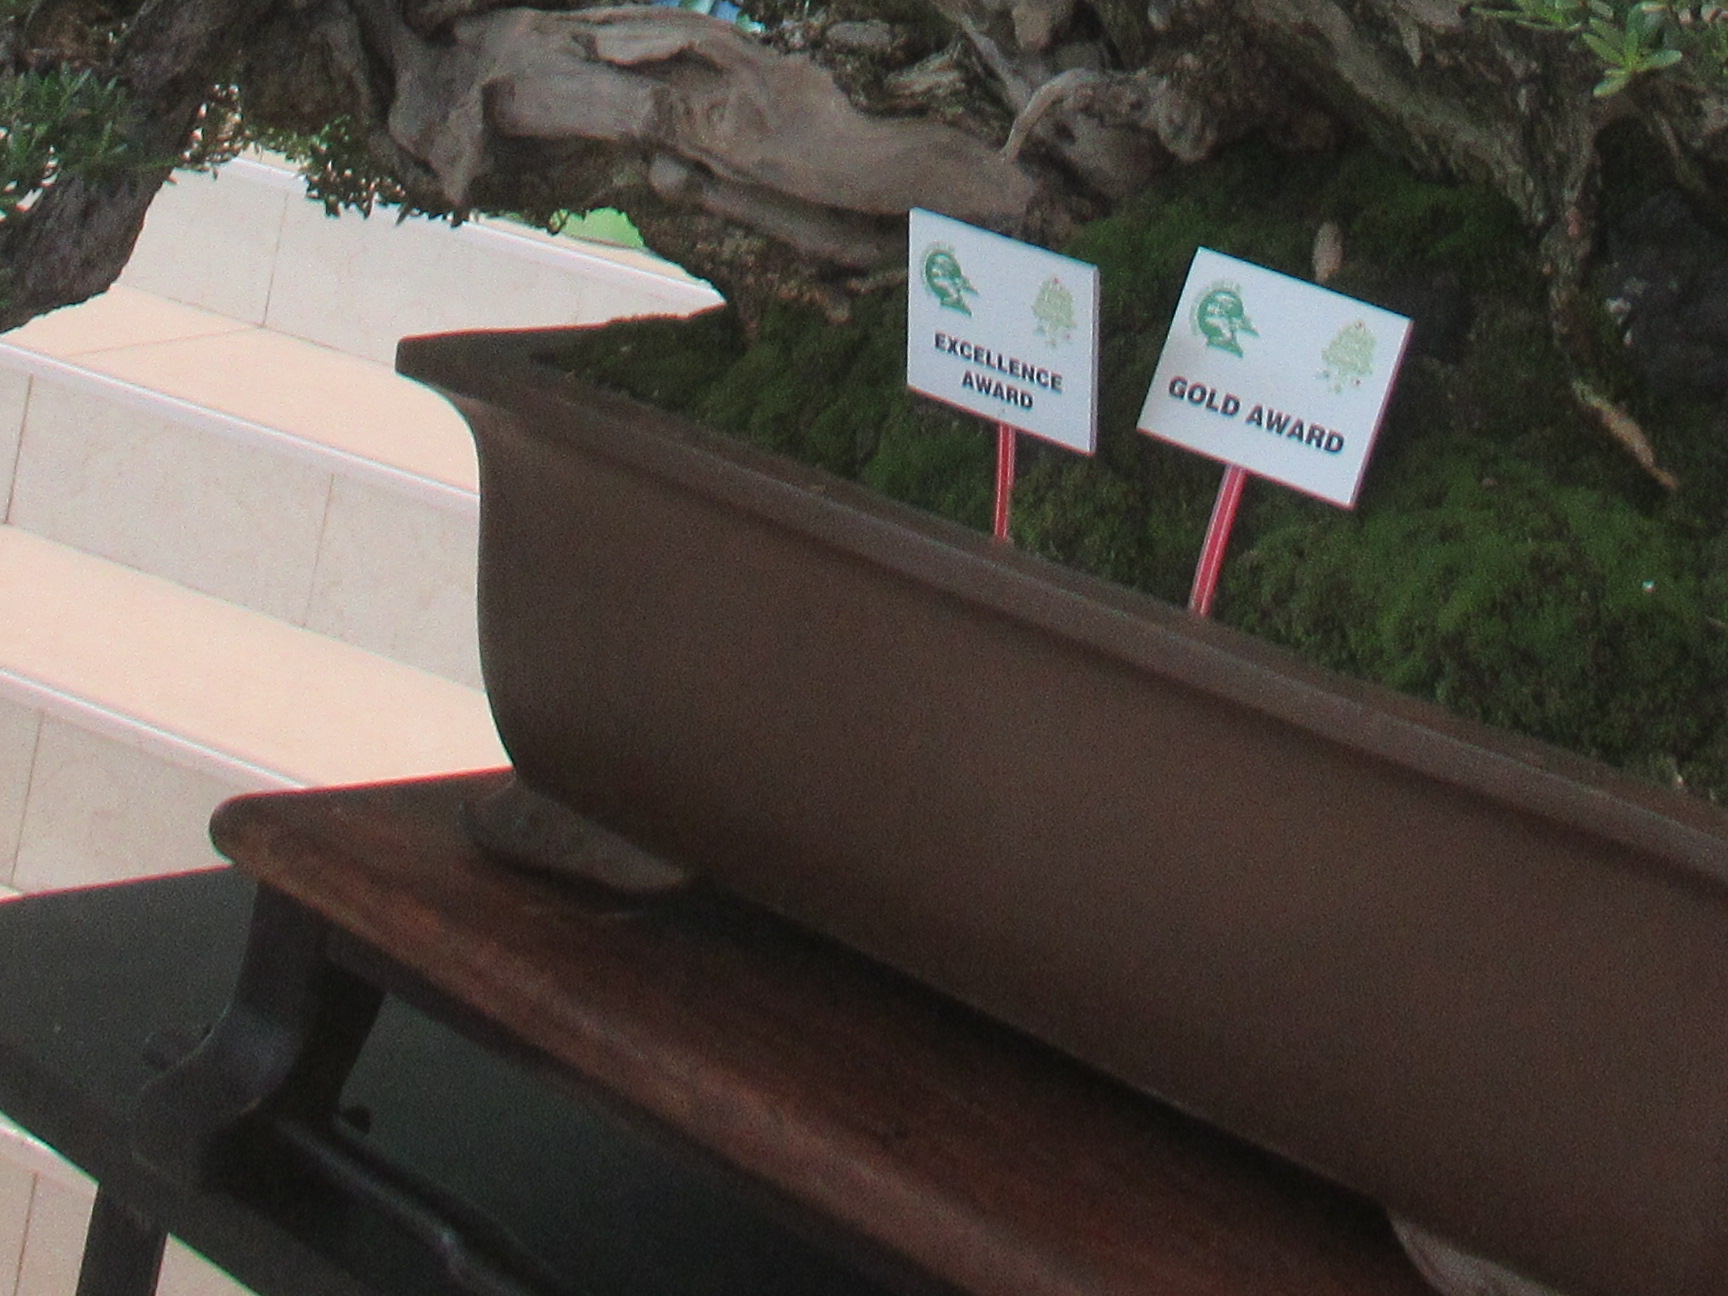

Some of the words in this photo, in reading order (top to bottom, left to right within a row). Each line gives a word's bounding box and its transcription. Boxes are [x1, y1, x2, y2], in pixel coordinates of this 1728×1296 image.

[934, 330, 1063, 392] EXCELLENCE
[961, 369, 1034, 409] AWARD
[1168, 375, 1241, 417] GOLD
[1245, 404, 1345, 454] AWARD
